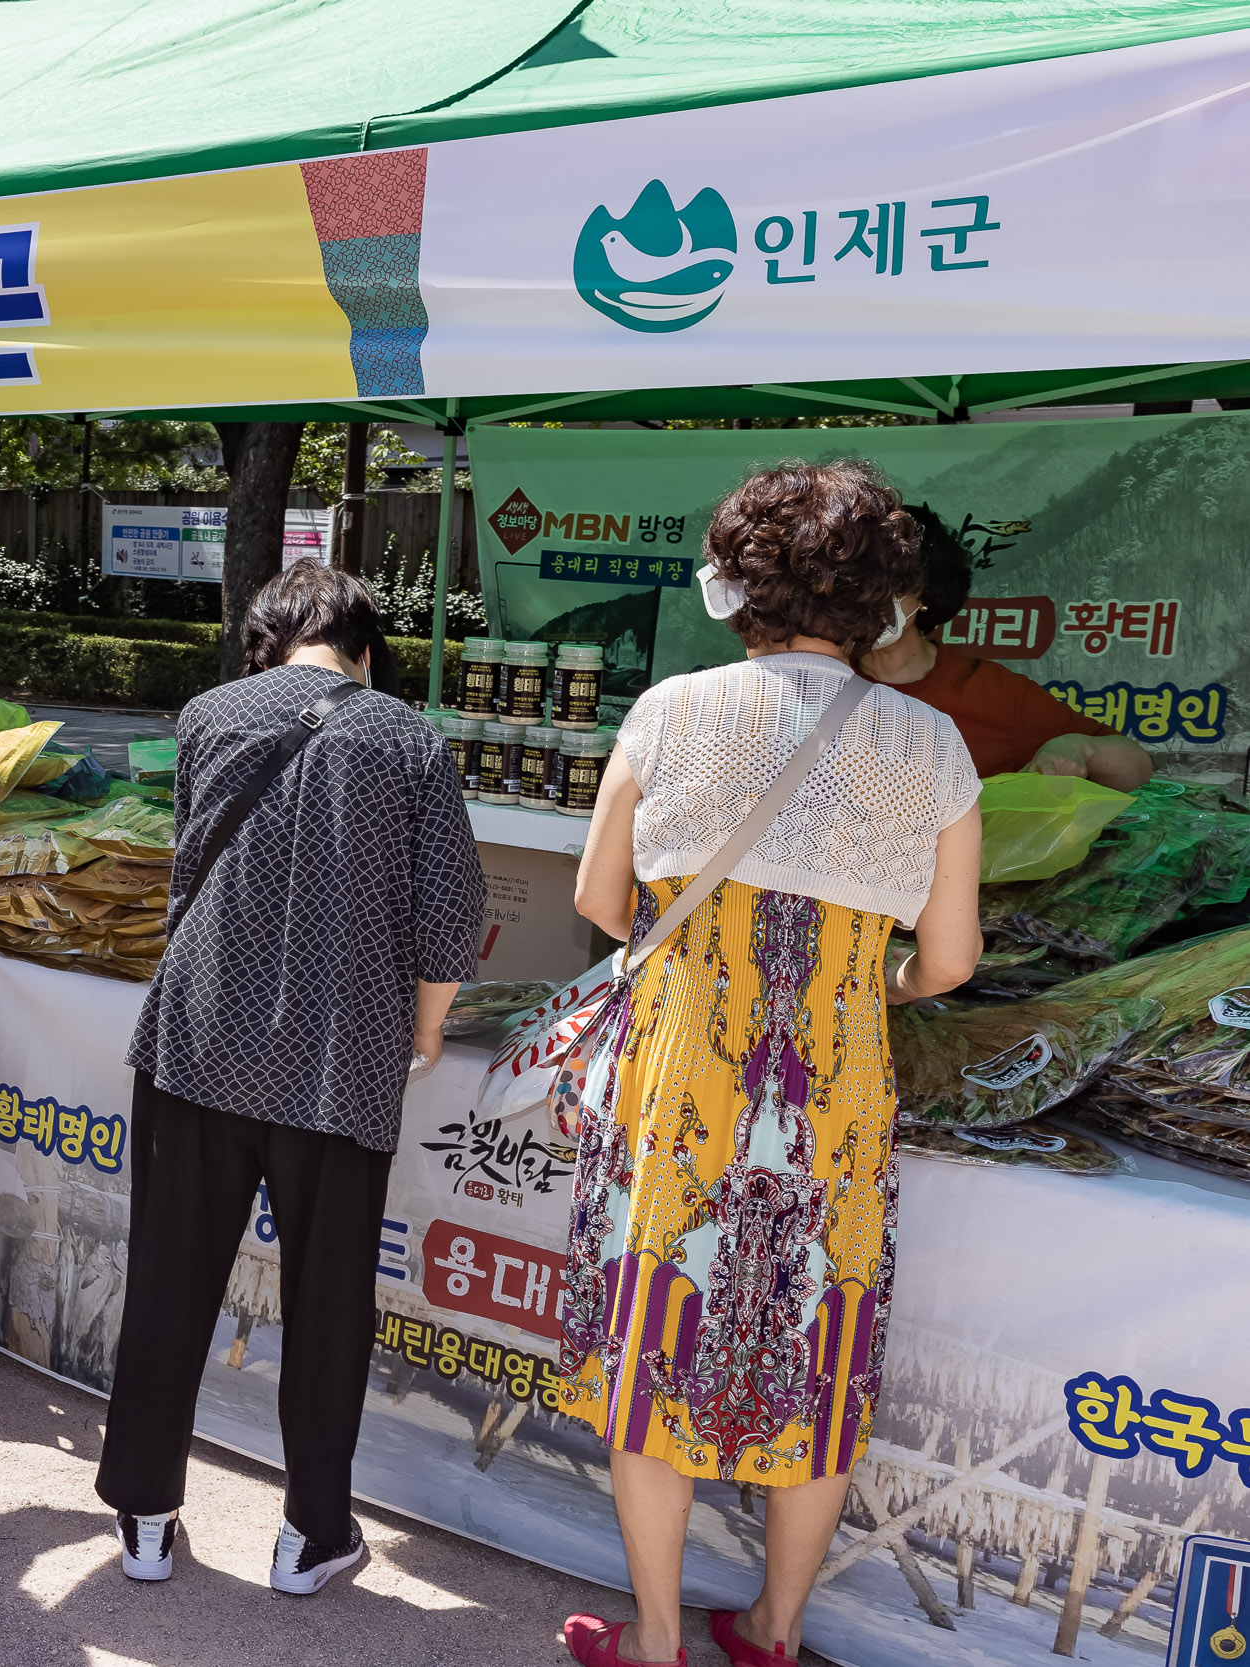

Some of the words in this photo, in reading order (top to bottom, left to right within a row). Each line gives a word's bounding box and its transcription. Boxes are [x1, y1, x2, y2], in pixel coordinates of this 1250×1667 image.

[754, 195, 1001, 285] 인제군
[506, 501, 530, 514] 생생
[182, 511, 201, 525] 공원
[497, 514, 538, 530] 정보마당
[542, 511, 630, 542] MBN
[638, 515, 686, 544] 방영
[503, 532, 527, 541] LIVE
[551, 555, 598, 574] 용대리
[608, 559, 639, 578] 직영
[649, 561, 684, 581] 매장
[942, 608, 1039, 648] 대리
[1063, 601, 1179, 657] 황태
[466, 674, 485, 688] 황태
[514, 678, 533, 692] 황태
[569, 682, 589, 697] 황태
[466, 1181, 493, 1200] 용대리
[497, 1188, 524, 1208] 황태
